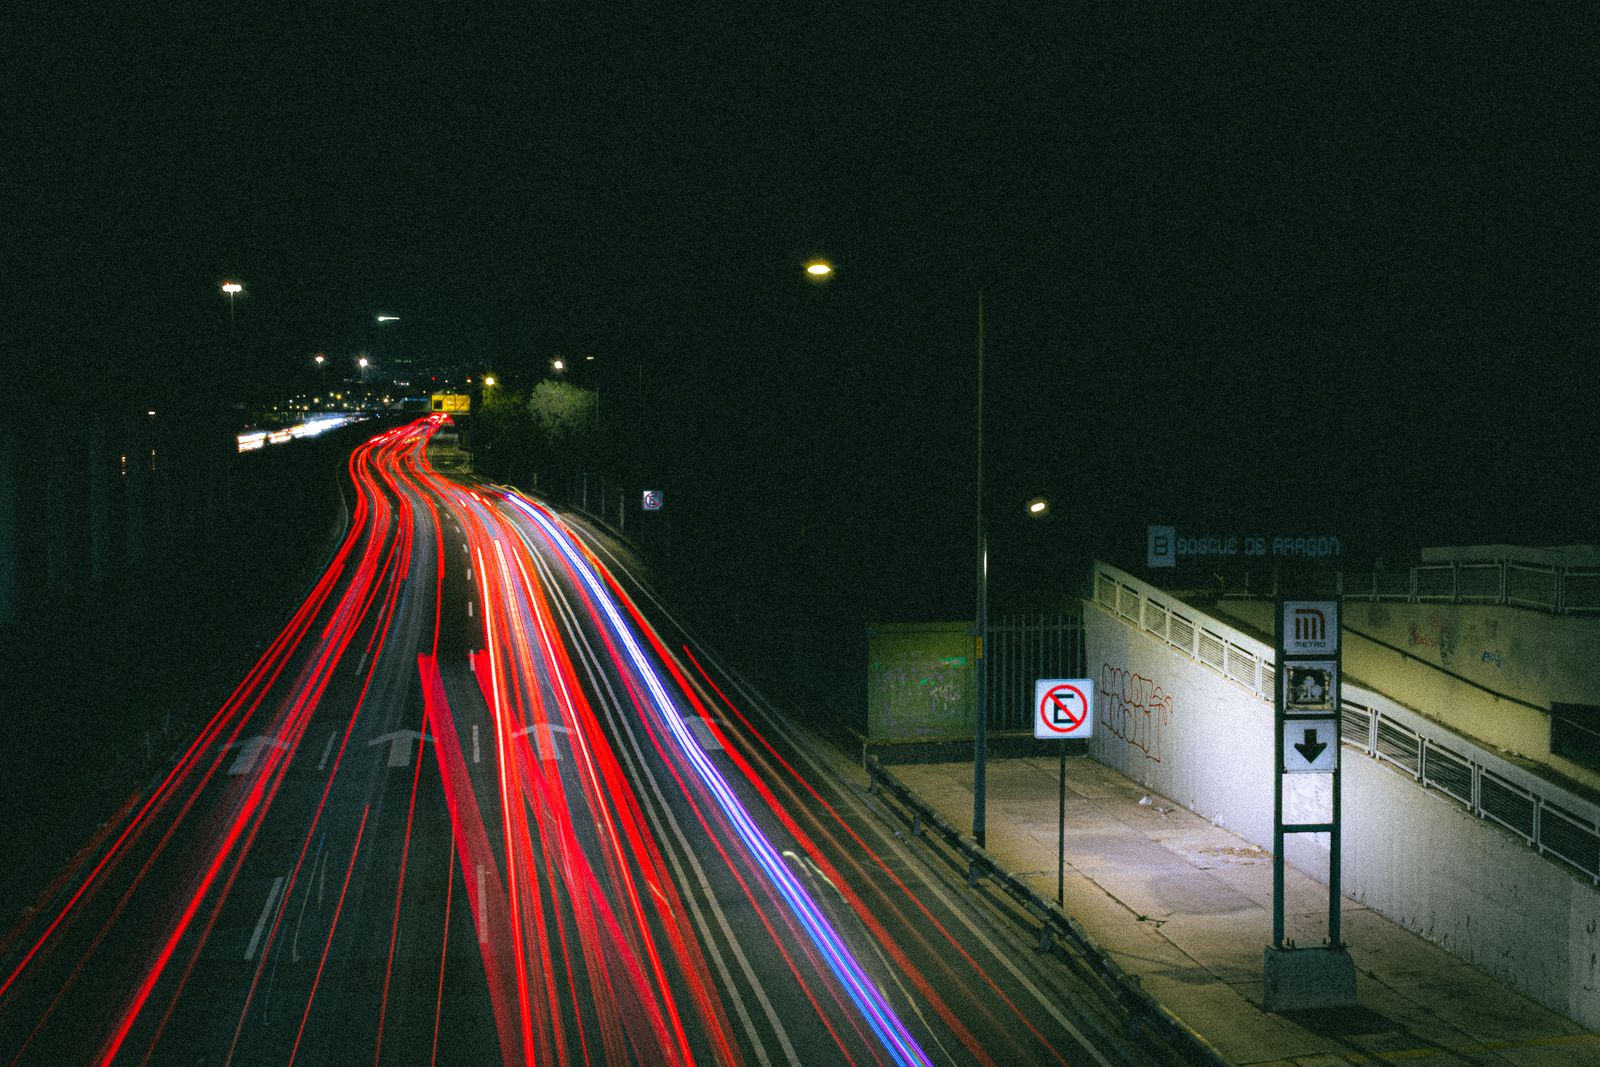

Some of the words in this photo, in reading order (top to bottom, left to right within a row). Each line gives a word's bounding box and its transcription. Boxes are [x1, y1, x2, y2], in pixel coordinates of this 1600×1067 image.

[1153, 536, 1169, 556] B
[1244, 537, 1266, 556] DE
[1053, 693, 1075, 724] E
